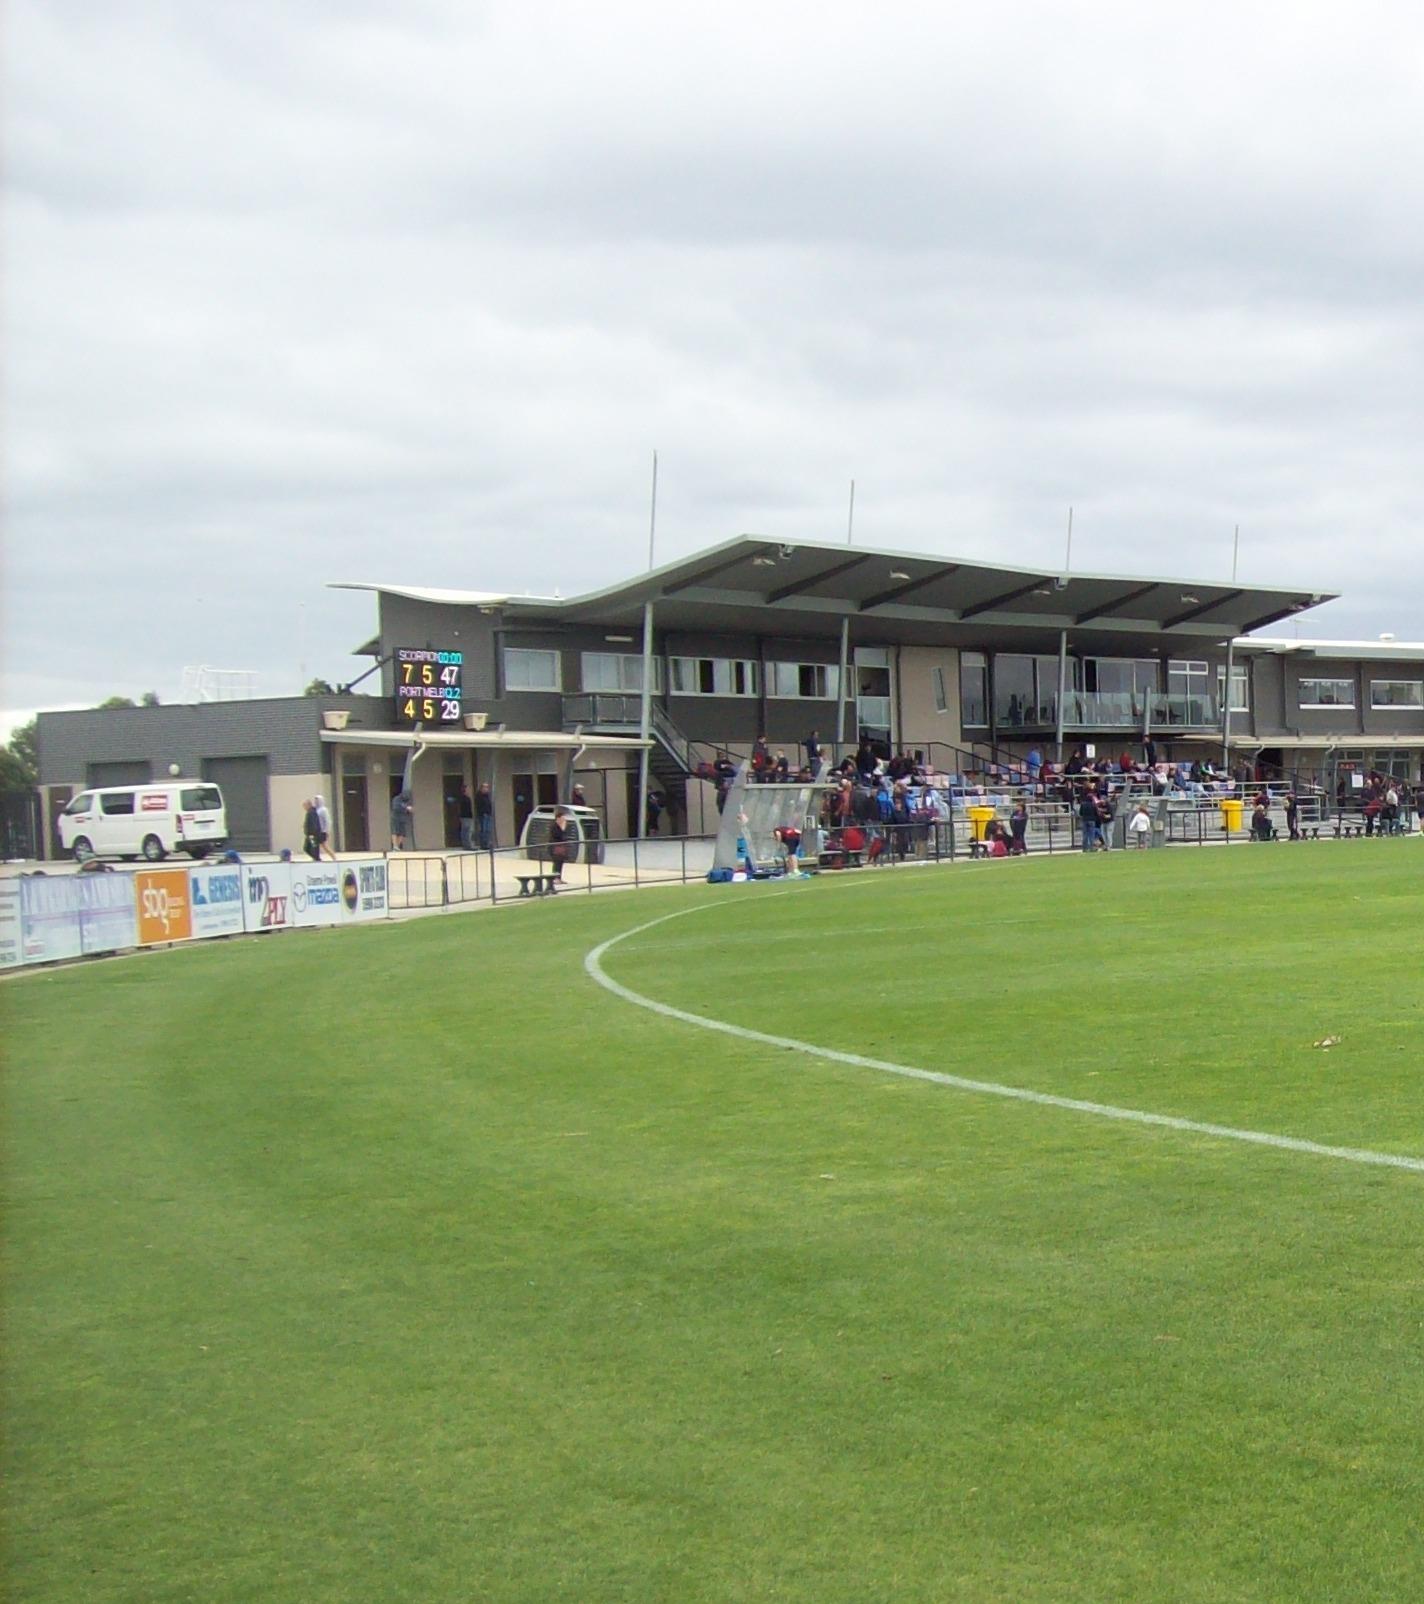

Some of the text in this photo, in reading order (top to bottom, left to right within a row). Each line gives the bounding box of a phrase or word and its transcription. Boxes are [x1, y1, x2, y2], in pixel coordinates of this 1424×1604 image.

[403, 664, 459, 686] 7 5 47
[399, 686, 422, 697] PORT
[404, 699, 460, 719] 4 5 29
[307, 888, 340, 906] mazda
